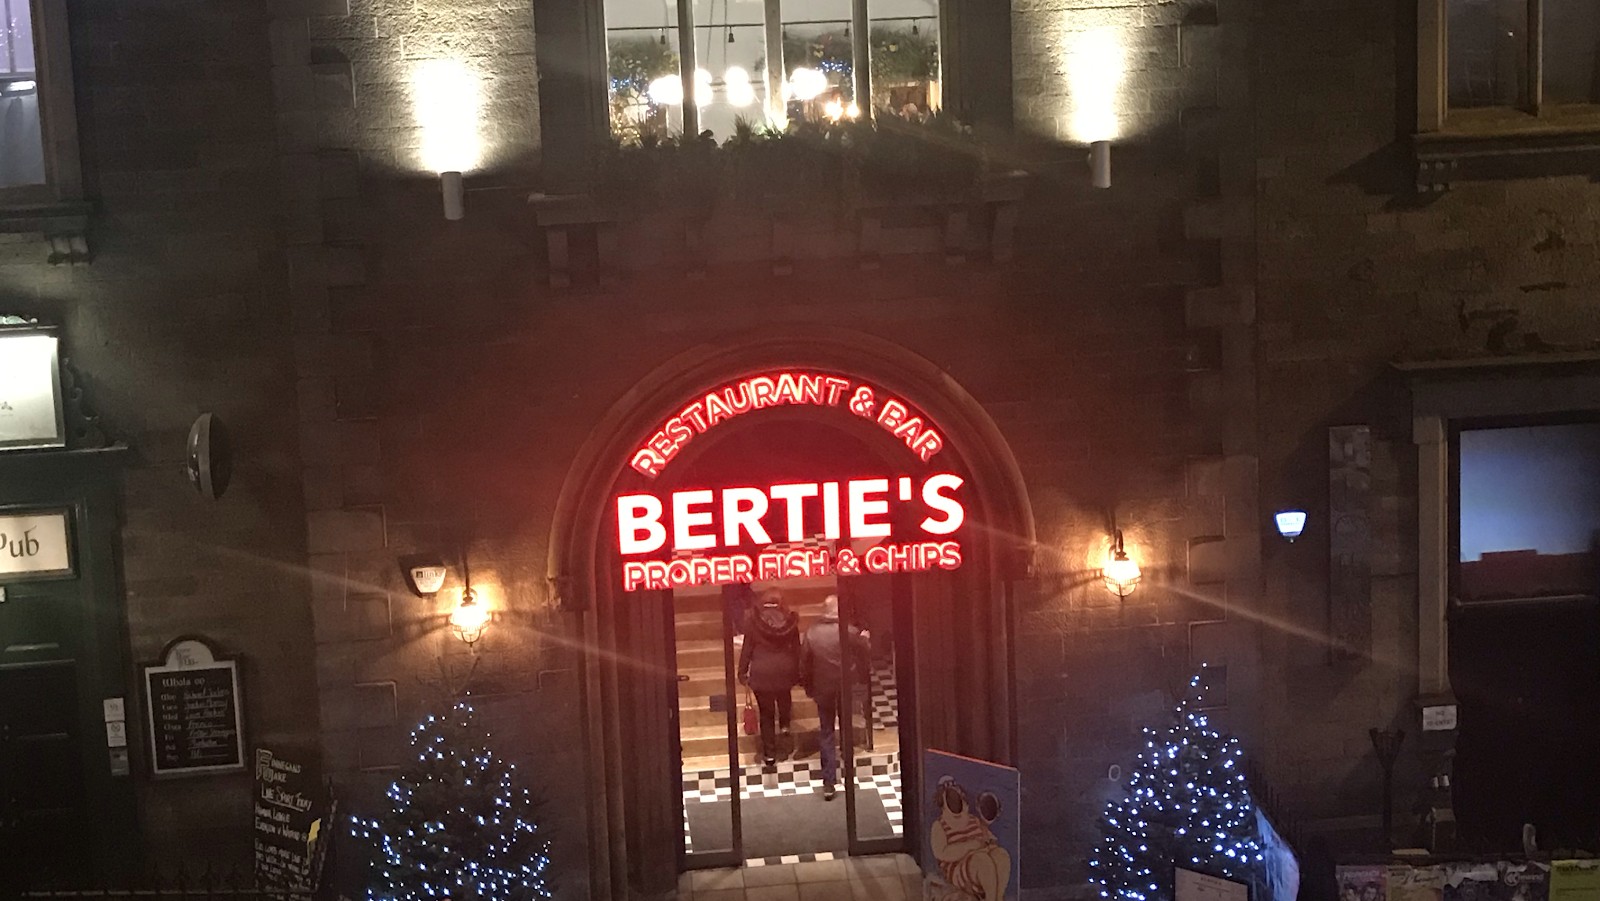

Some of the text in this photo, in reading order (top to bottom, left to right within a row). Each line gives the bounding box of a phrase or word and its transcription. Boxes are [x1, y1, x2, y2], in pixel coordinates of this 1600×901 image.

[629, 373, 943, 479] RESTAURANT & BAR
[617, 473, 966, 556] BERTIE'S
[623, 541, 962, 592] PROPER FISH & CHIPS
